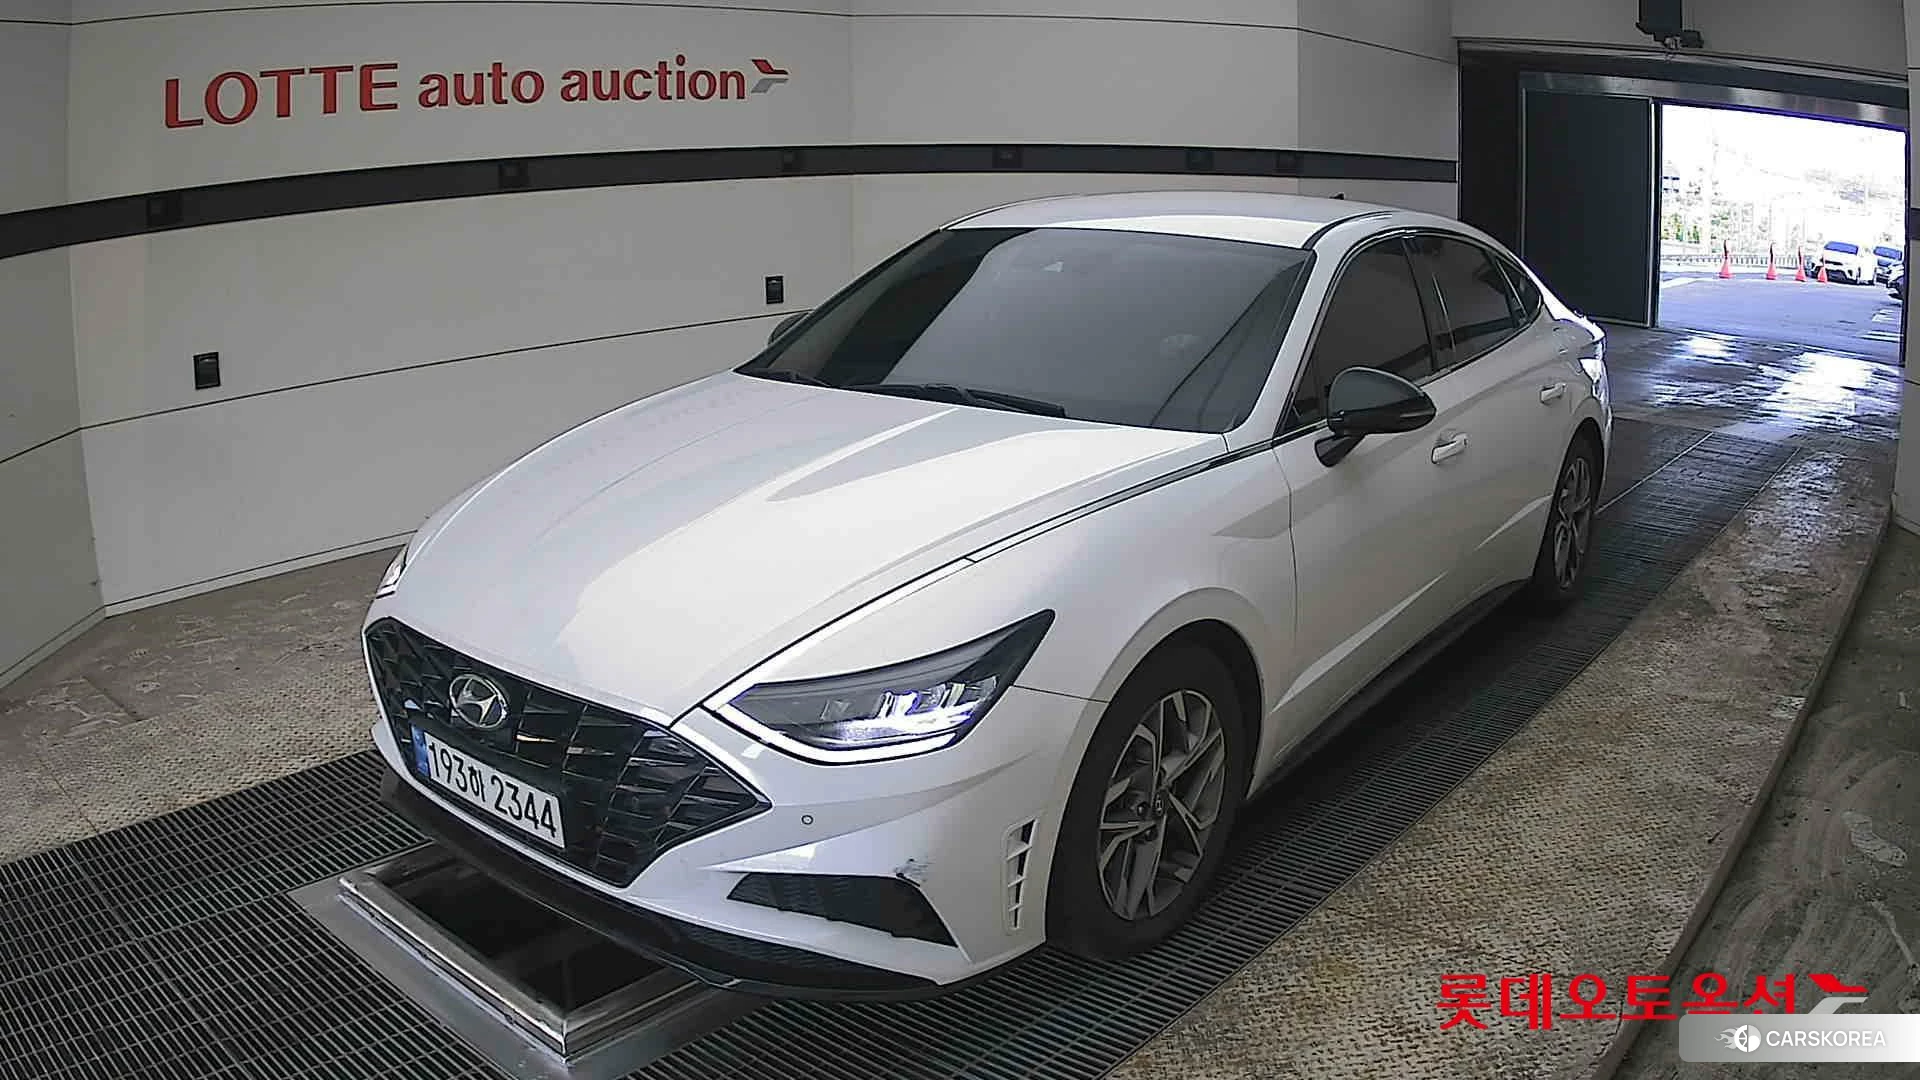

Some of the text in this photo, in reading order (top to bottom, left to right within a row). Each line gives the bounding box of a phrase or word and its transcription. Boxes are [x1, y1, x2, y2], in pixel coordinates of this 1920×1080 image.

[165, 55, 746, 129] LOTTE auto auction
[491, 775, 556, 838] 2344
